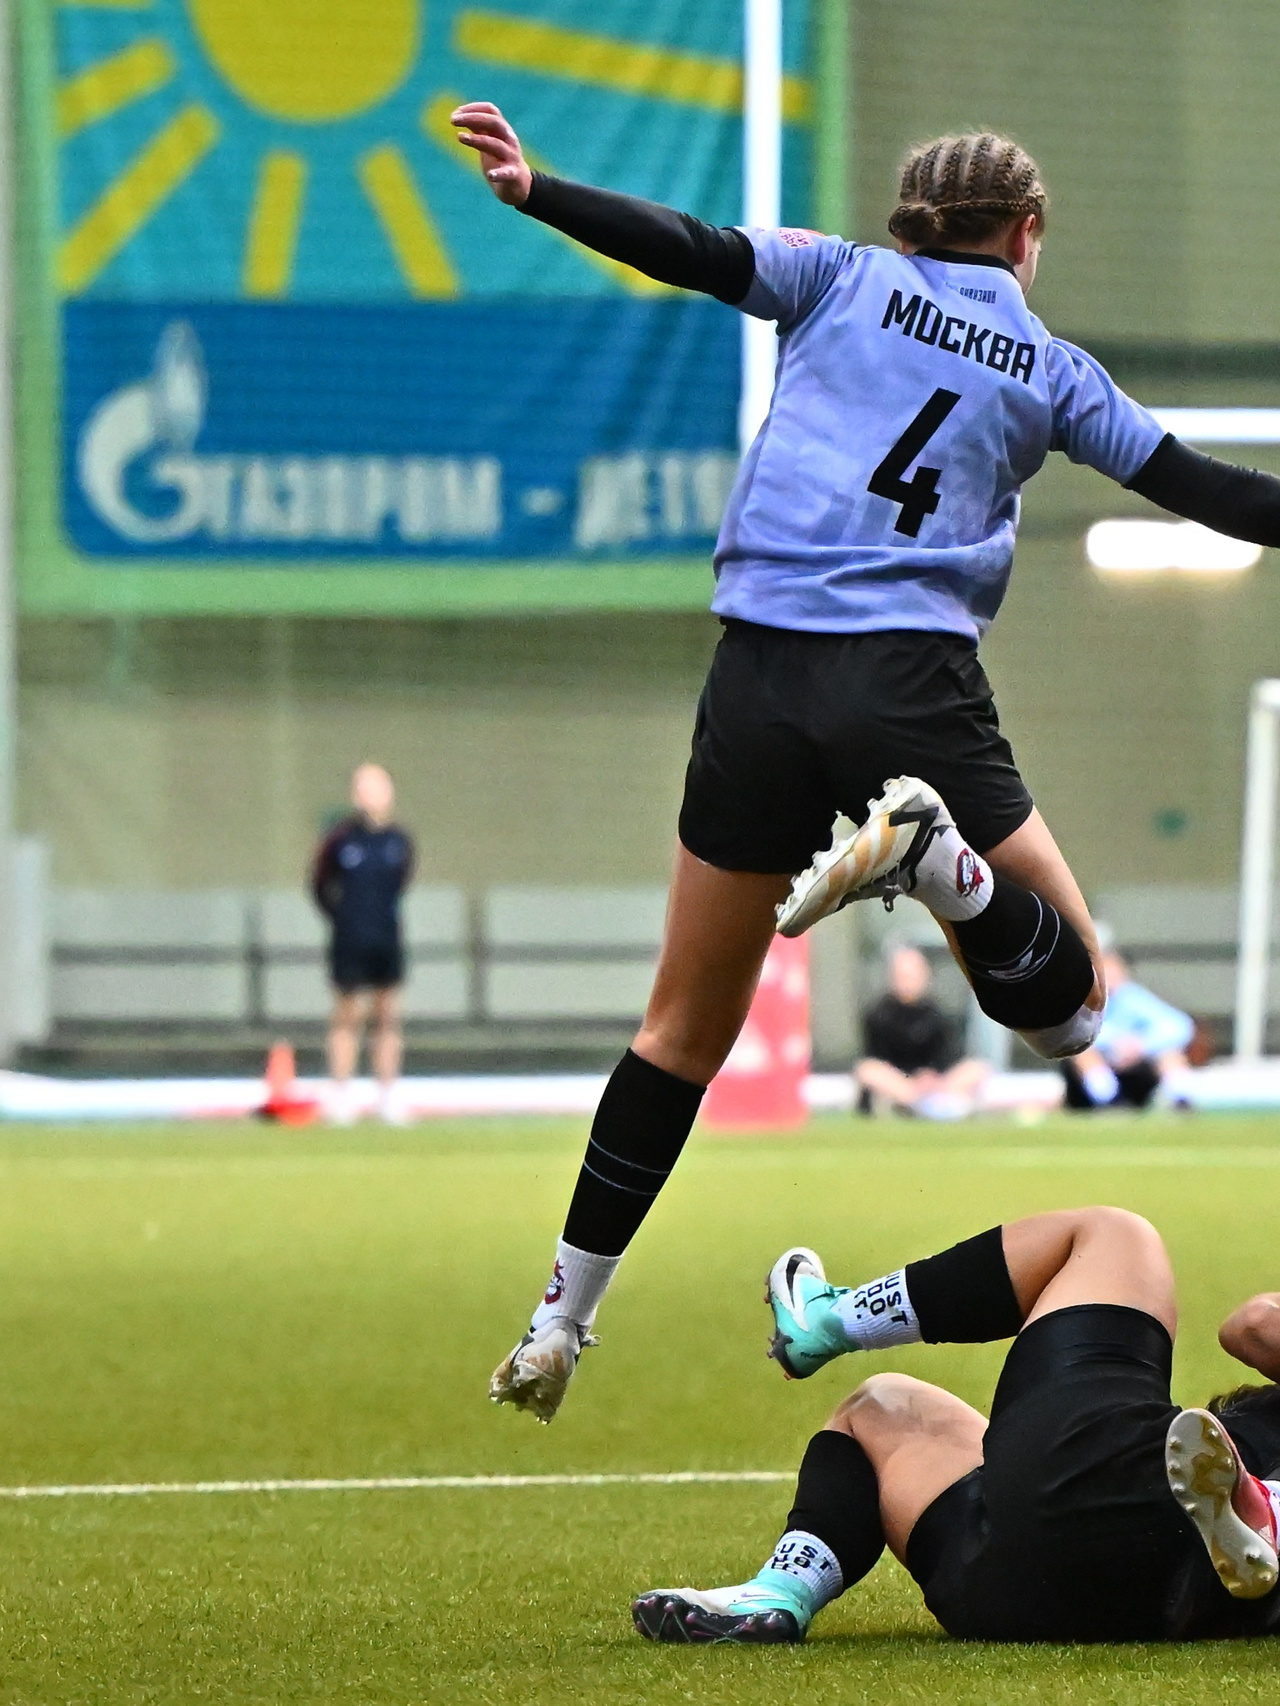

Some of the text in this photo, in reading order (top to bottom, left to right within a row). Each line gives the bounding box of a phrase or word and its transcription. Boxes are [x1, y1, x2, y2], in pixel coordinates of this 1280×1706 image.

[881, 288, 1036, 385] МОСКВА
[867, 387, 962, 538] 4
[777, 1542, 833, 1571] UST
